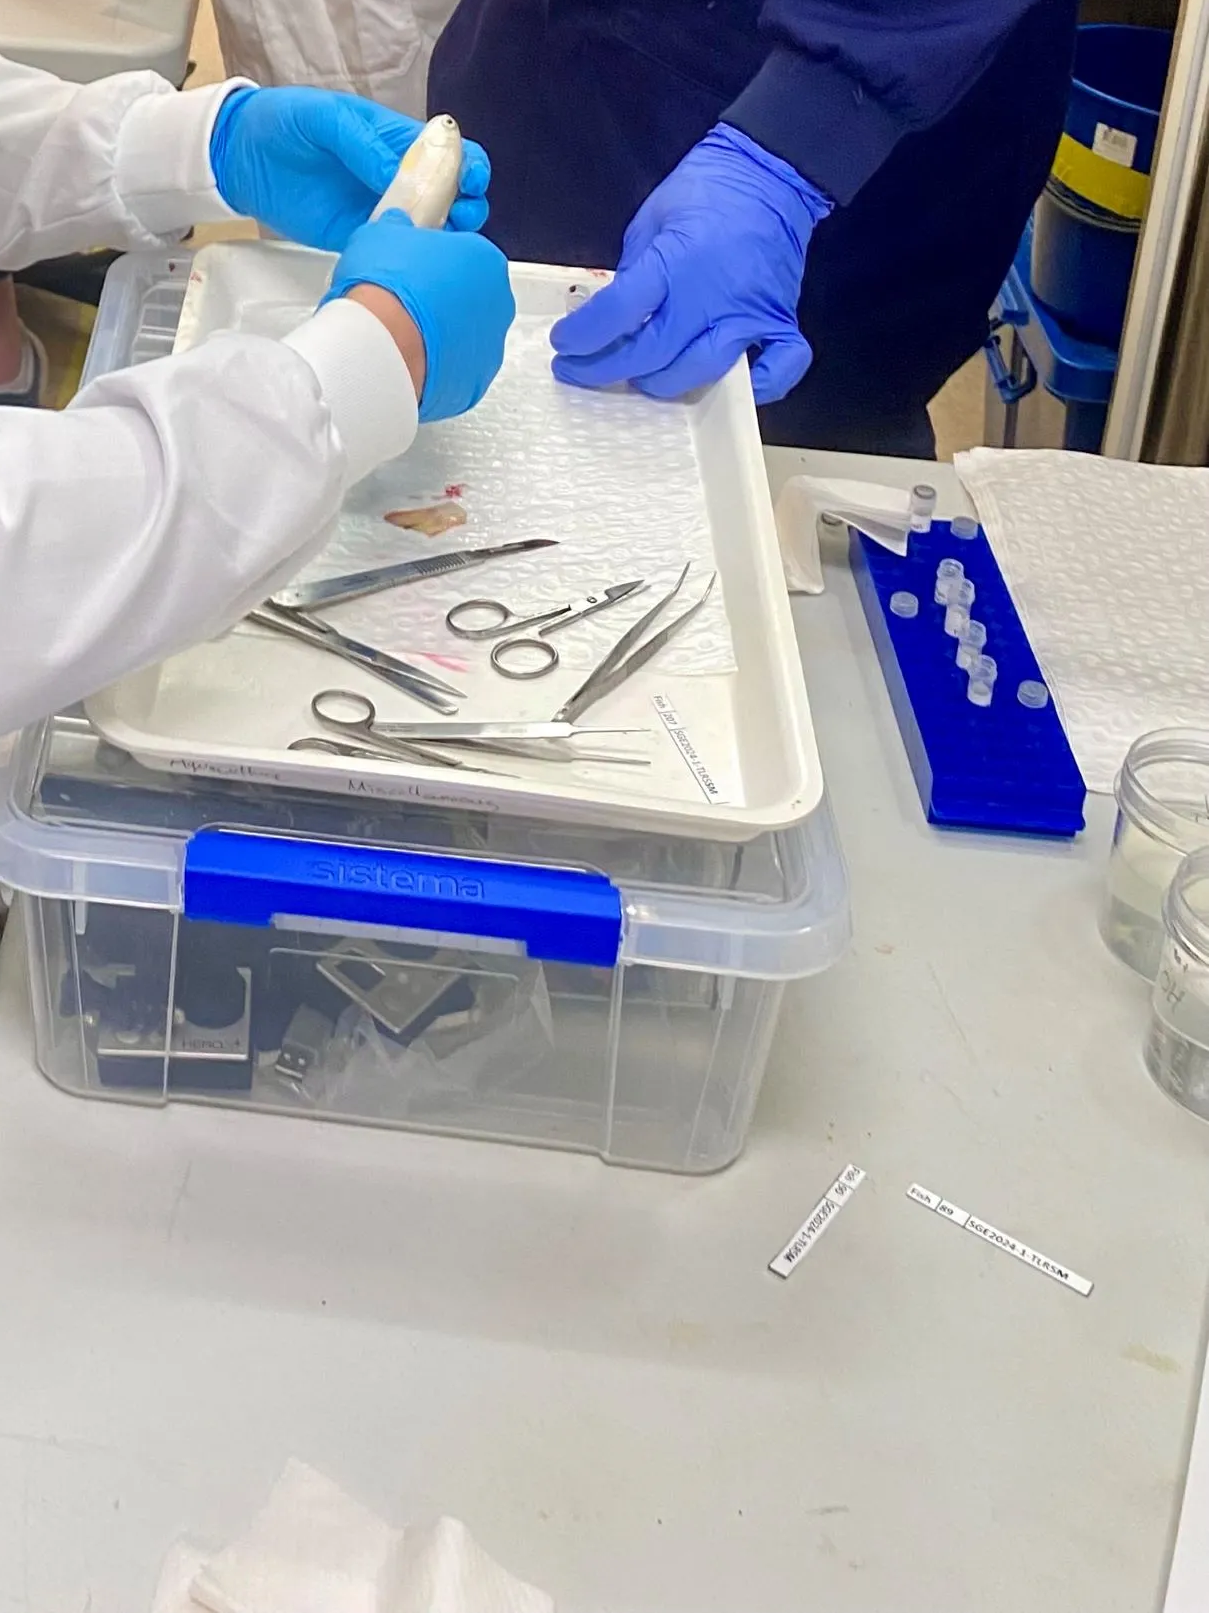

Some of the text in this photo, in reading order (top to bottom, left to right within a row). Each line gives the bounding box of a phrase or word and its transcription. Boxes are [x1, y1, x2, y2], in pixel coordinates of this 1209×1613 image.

[654, 694, 666, 709] Fish
[663, 713, 678, 726] 207
[309, 857, 486, 902] sistema
[910, 1187, 1070, 1281] Fish 89 SGE2024-1-TLRSM
